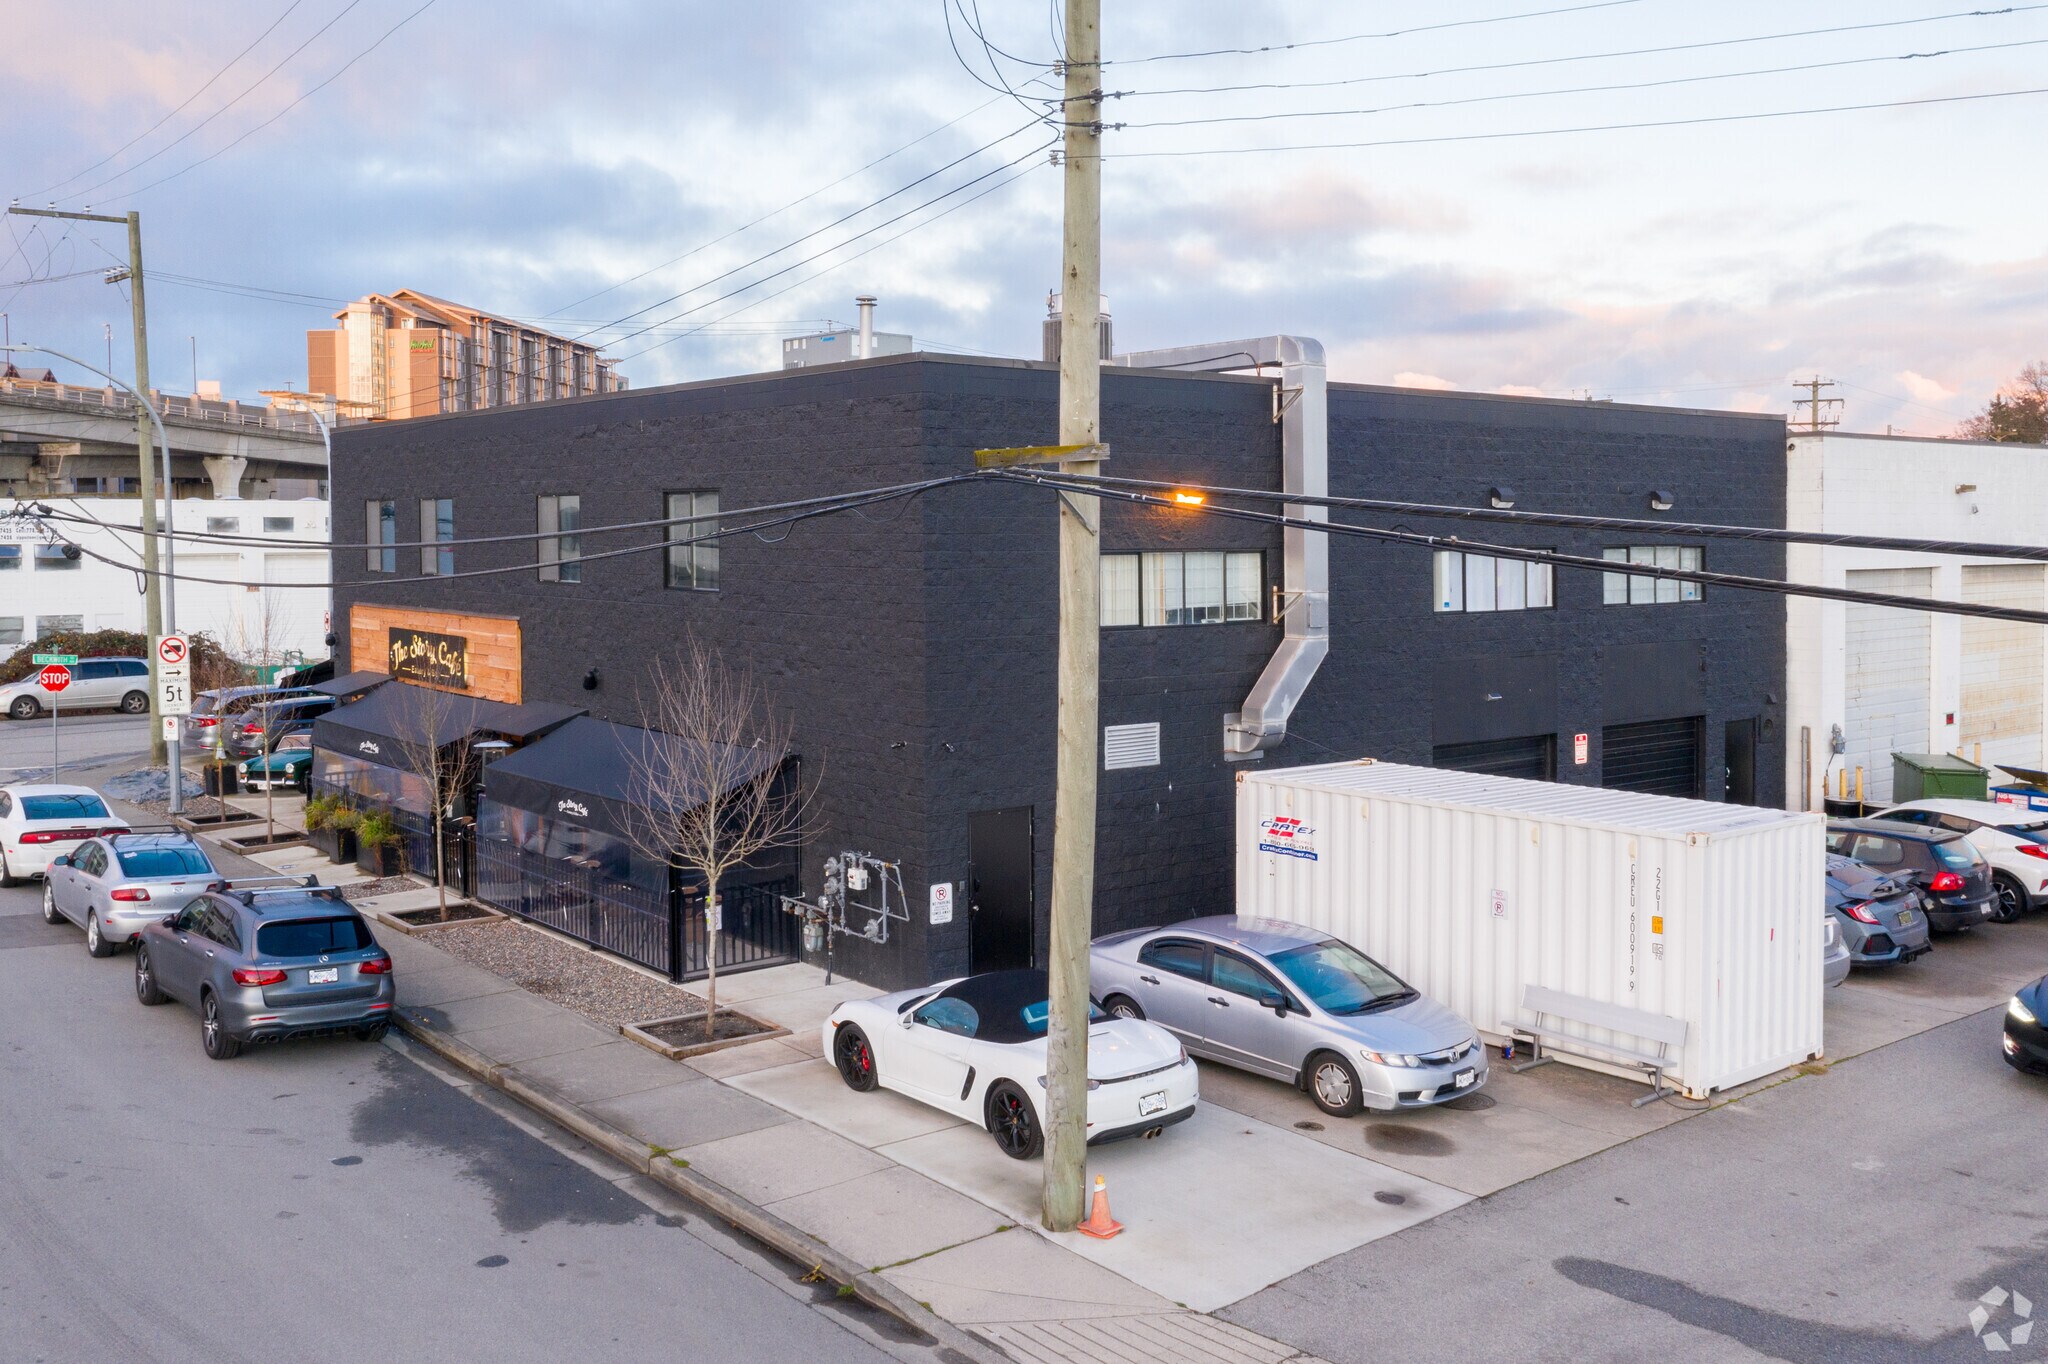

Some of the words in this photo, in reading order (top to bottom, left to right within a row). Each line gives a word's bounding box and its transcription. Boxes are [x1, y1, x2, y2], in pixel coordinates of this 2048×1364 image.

[392, 640, 408, 670] The
[410, 634, 437, 665] Story
[439, 641, 462, 676] Café
[41, 673, 69, 684] STOP
[1261, 820, 1316, 835] CRATEX
